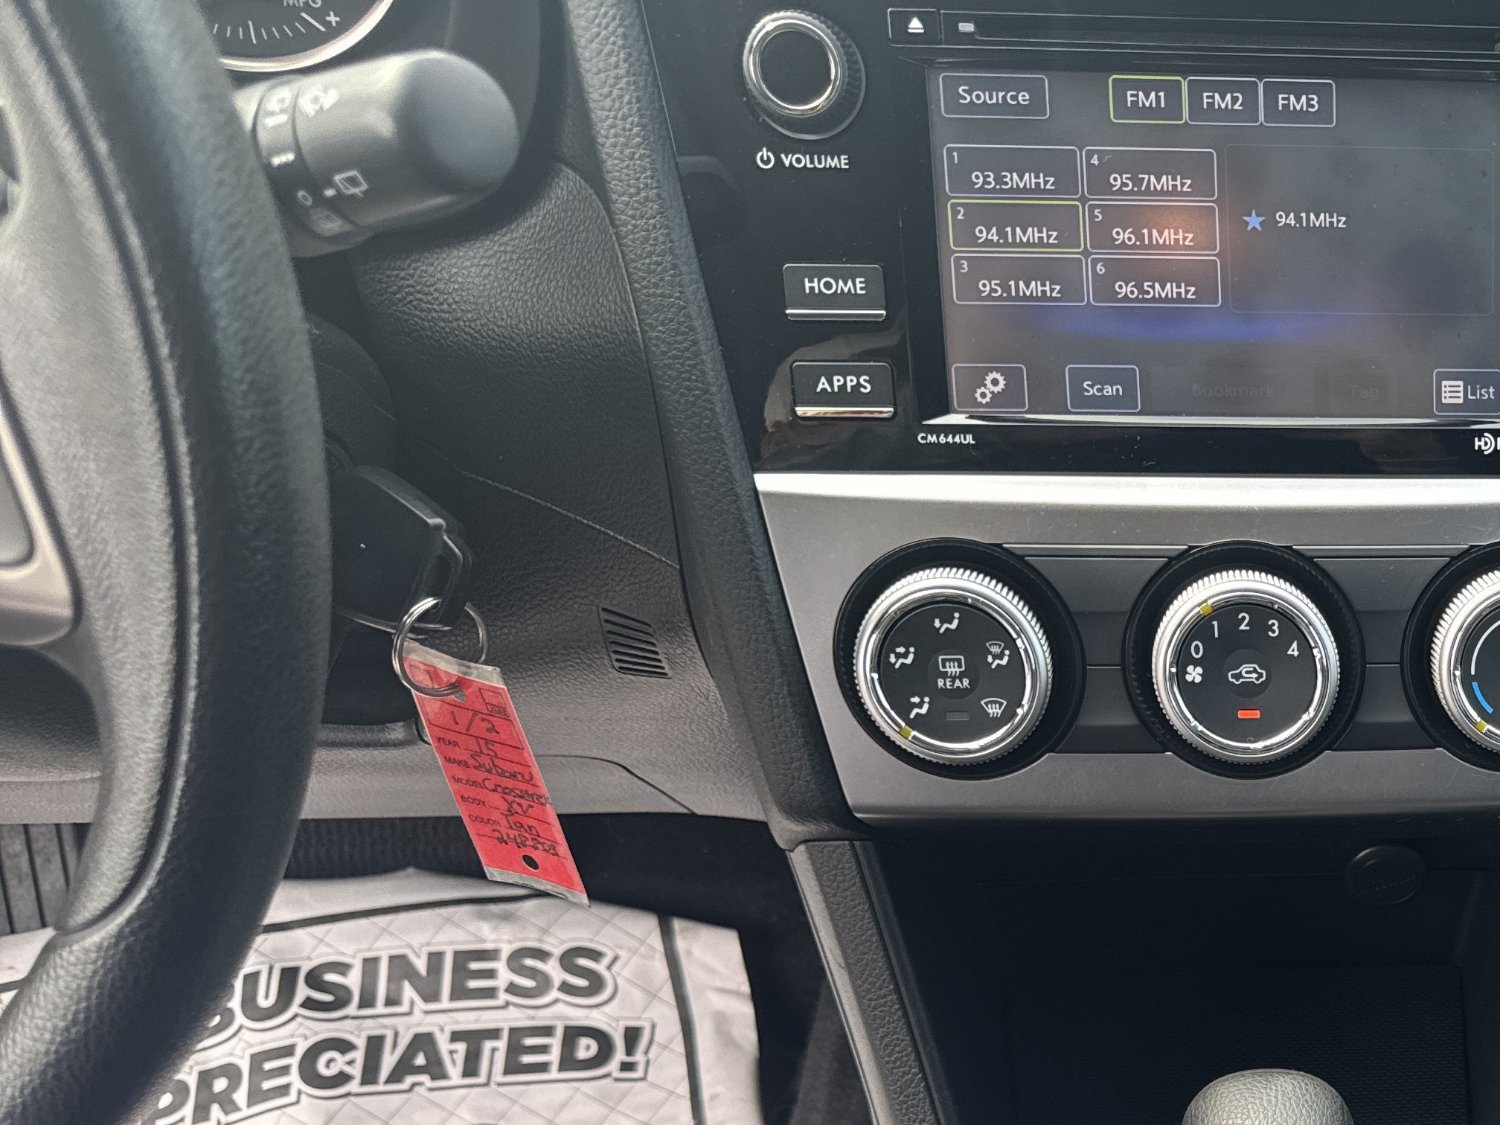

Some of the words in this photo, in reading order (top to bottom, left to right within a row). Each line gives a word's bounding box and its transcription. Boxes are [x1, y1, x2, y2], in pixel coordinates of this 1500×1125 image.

[957, 85, 1031, 105] Source
[1125, 90, 1167, 109] FM1
[1202, 92, 1244, 111] FM2
[1277, 94, 1320, 112] FM3
[780, 153, 849, 170] VOLUME
[951, 152, 959, 164] 1
[1090, 155, 1100, 167] 4
[970, 171, 1056, 191] 93.3MHz
[1109, 173, 1193, 193] 95.7MHz
[956, 207, 965, 220] 2
[1094, 209, 1103, 222] 5
[1275, 211, 1347, 230] 94.1MHz
[974, 225, 1059, 246] 94.1MHz
[1111, 227, 1195, 247] 96.1MHz
[960, 261, 969, 274] 3
[1096, 262, 1106, 275] 6
[803, 277, 867, 295] HOME
[978, 279, 1062, 299] 95.1MHz
[1114, 281, 1197, 301] 96.5MHz
[815, 376, 872, 394] APPS
[1083, 381, 1123, 398] Scan
[1467, 384, 1496, 401] List
[917, 432, 976, 445] CM644UL
[1474, 432, 1495, 455] HD
[1212, 620, 1219, 639] 1
[1237, 612, 1250, 630] 2
[1267, 619, 1280, 637] 3
[1287, 640, 1300, 658] 4
[937, 678, 970, 689] REAR
[436, 736, 461, 749] YEAR
